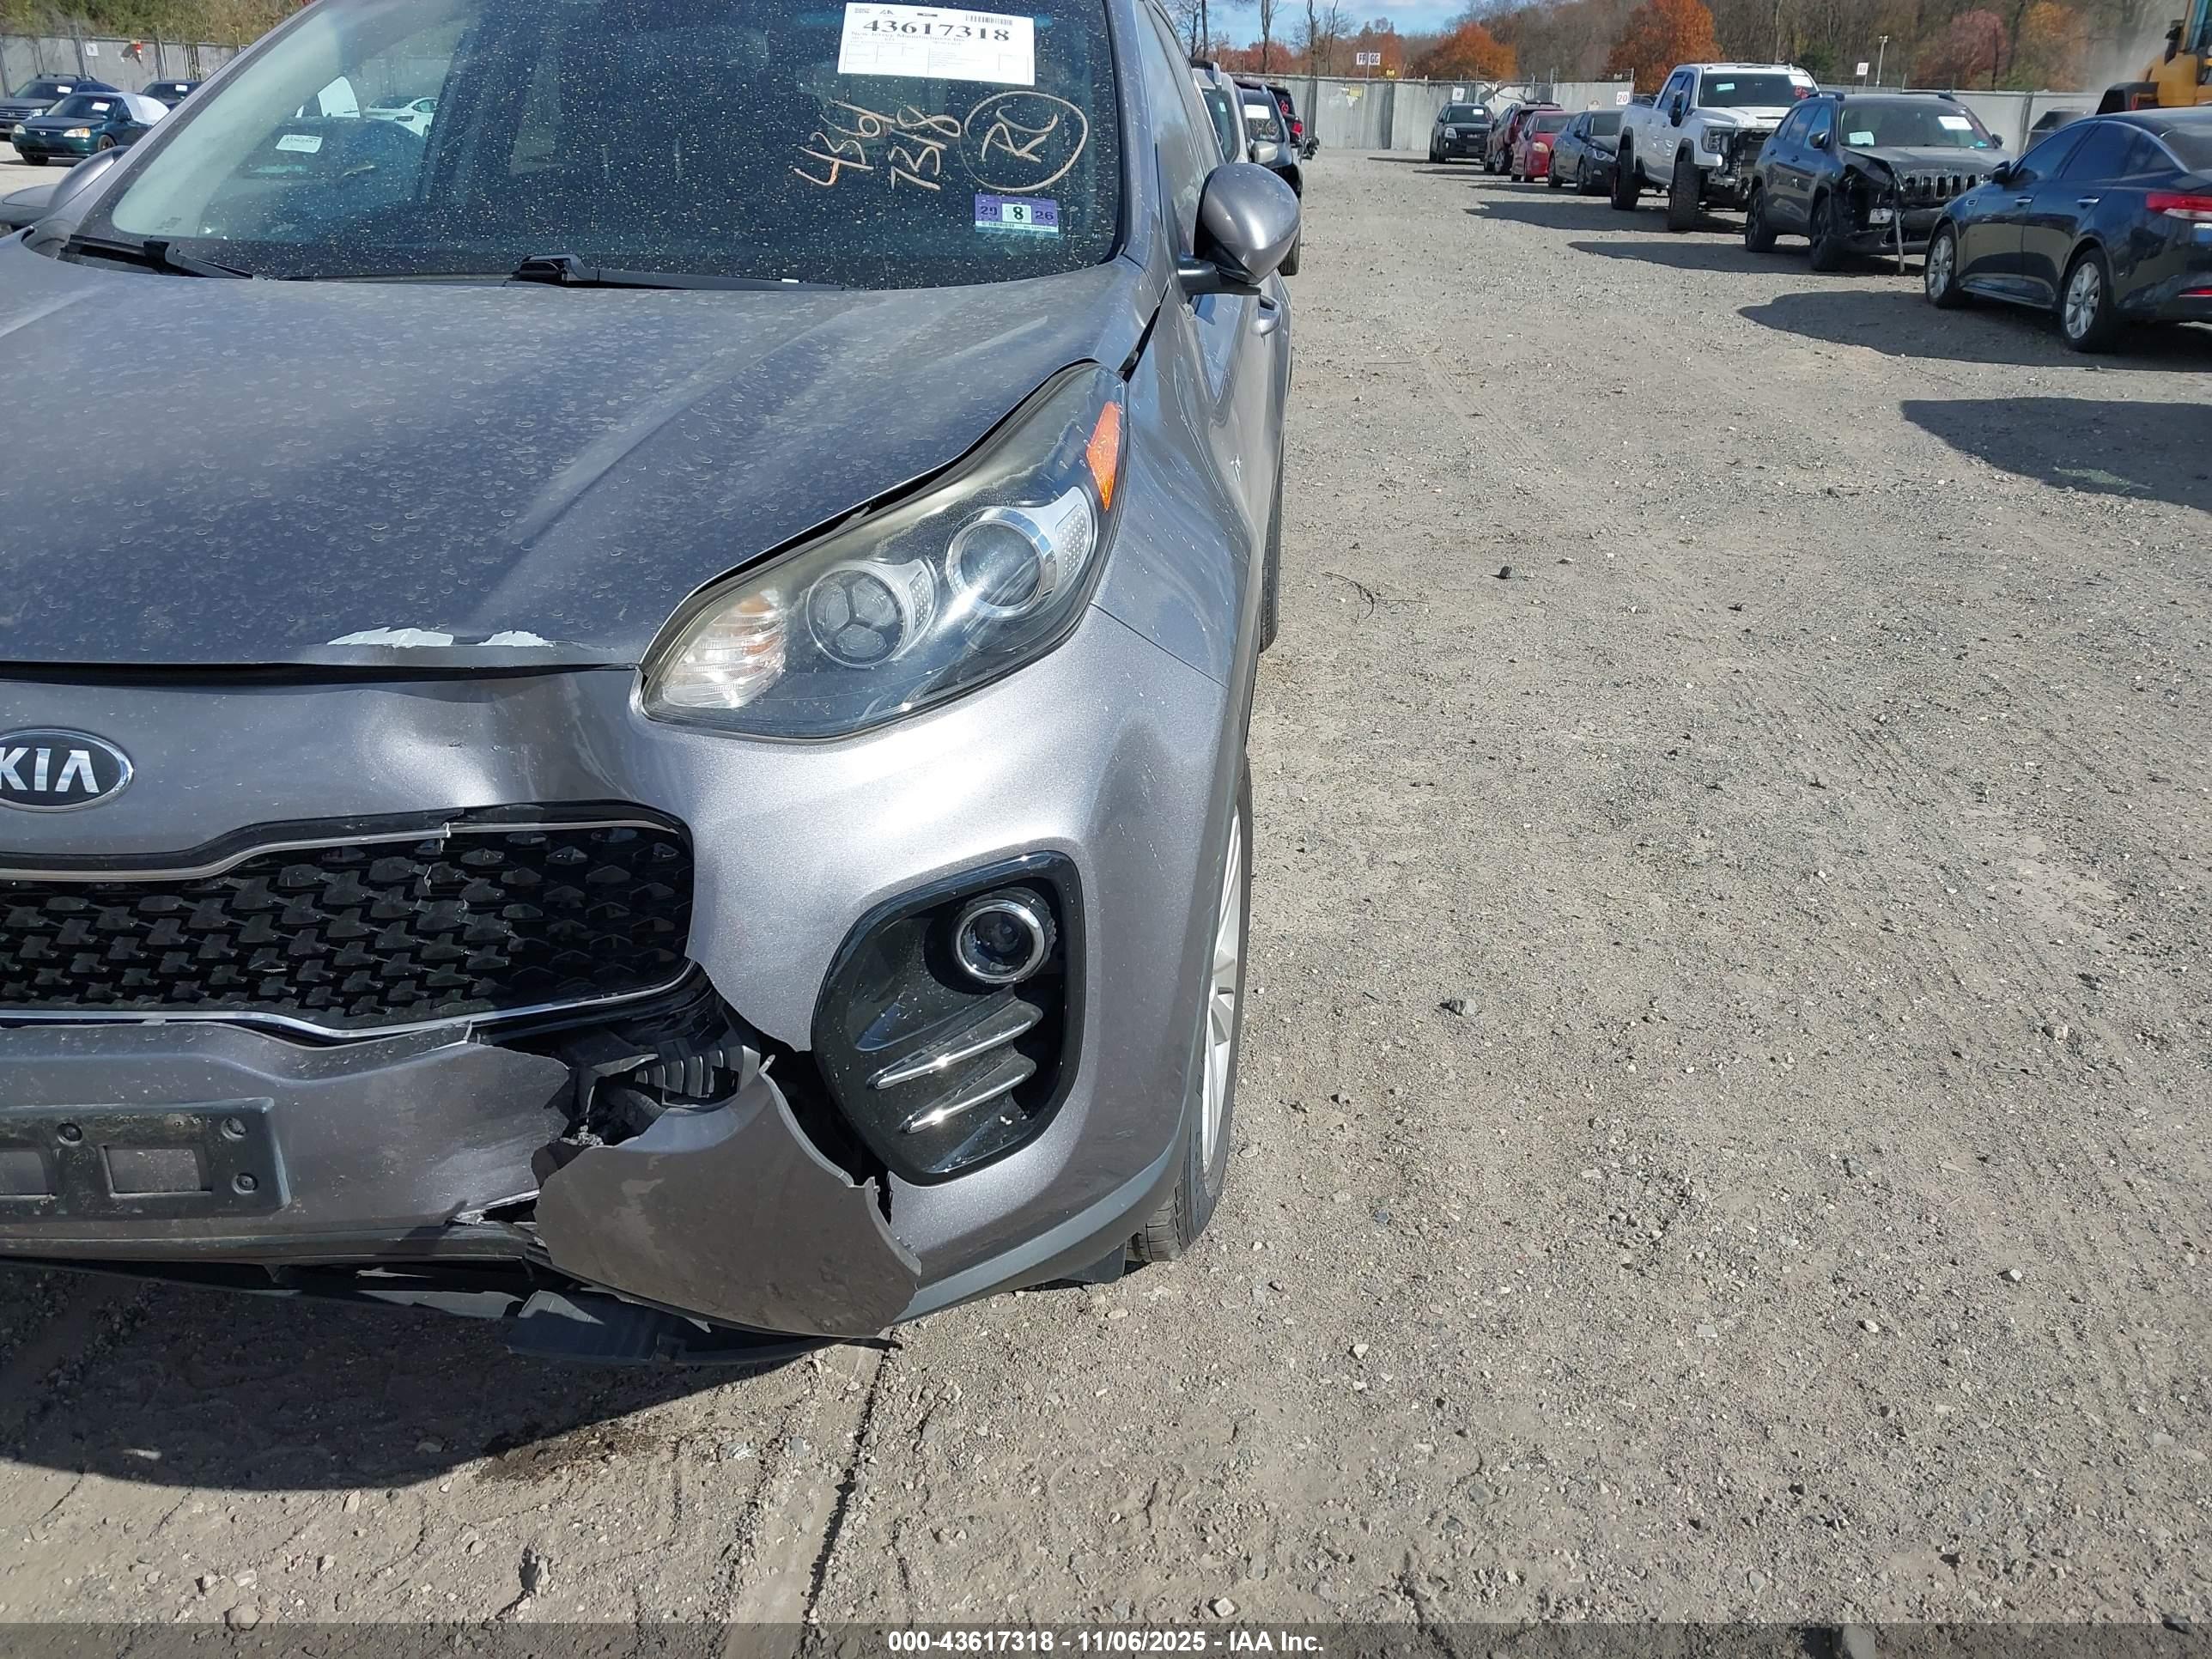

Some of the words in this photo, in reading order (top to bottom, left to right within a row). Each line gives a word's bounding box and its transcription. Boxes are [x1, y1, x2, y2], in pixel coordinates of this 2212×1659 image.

[864, 20, 1010, 42] 43617318
[1358, 54, 1366, 63] FF
[1370, 54, 1379, 64] GG
[1618, 94, 1628, 103] 20
[1013, 206, 1024, 221] 8
[1036, 210, 1054, 221] 26
[0, 747, 100, 793] KIA
